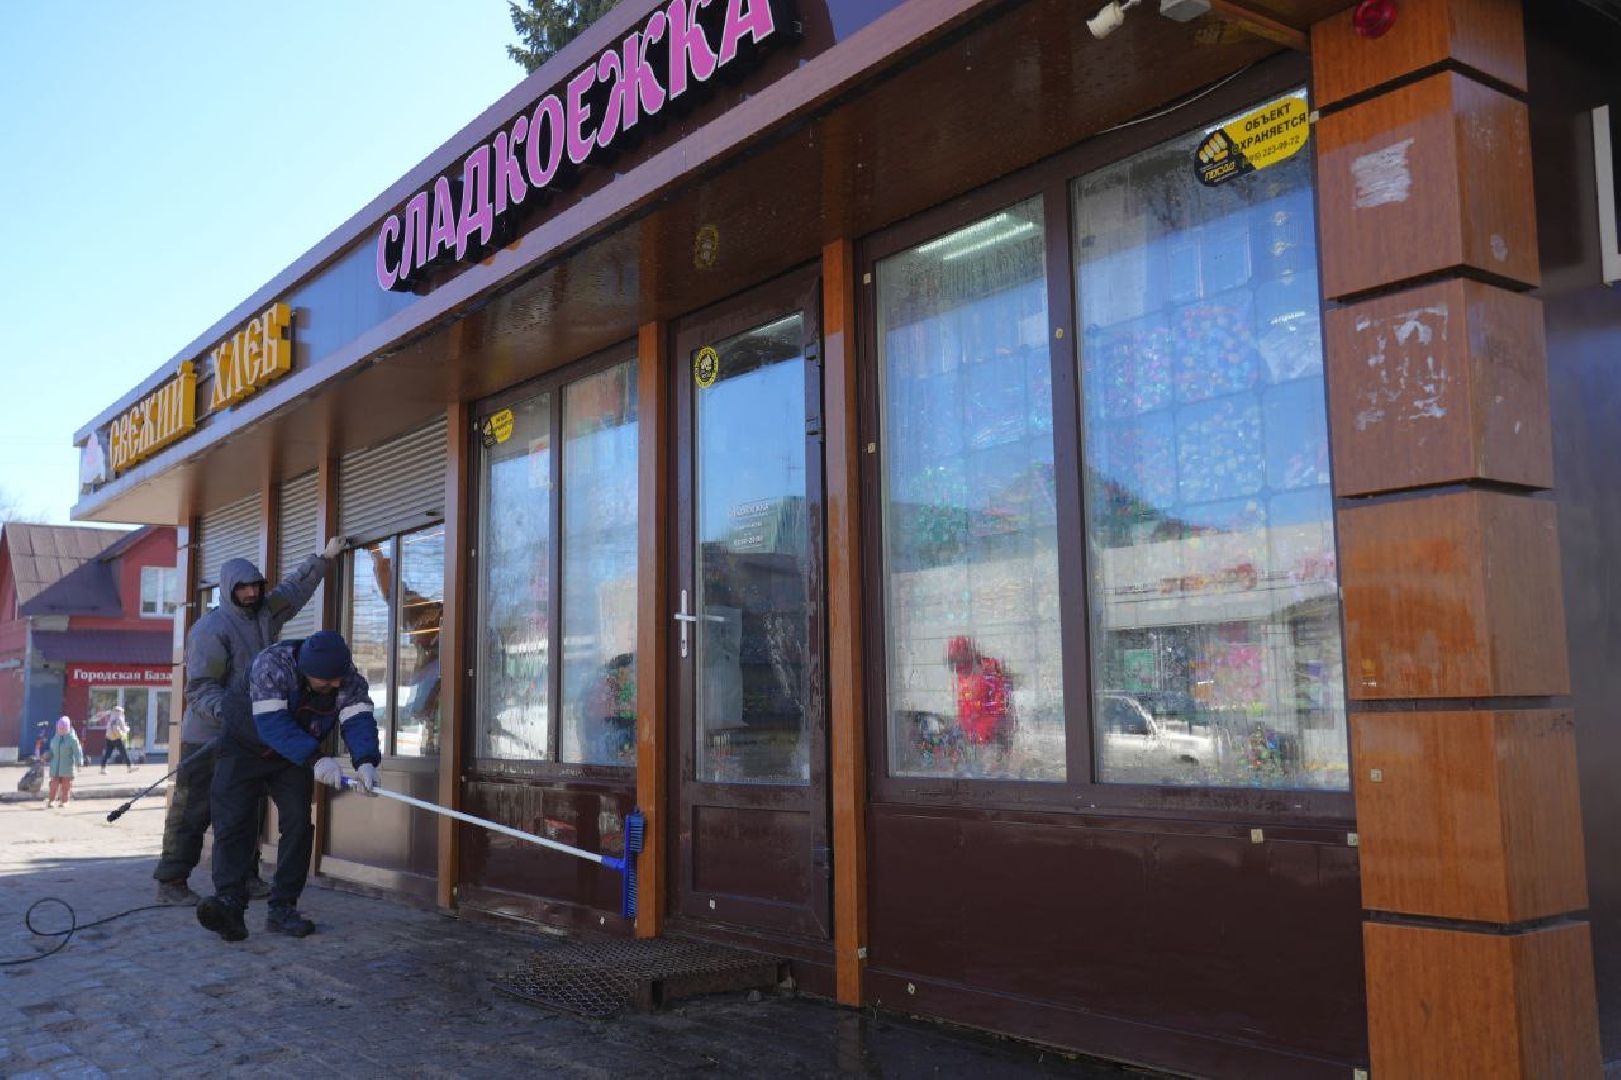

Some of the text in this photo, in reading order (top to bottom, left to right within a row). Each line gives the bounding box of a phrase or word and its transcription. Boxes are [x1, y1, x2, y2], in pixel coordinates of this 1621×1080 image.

[376, 0, 775, 291] СЛАДКОЕЖКА
[1245, 102, 1291, 132] ОБЪЕКТ
[109, 303, 288, 472] СВЕЖИЙ ХЛЕБ
[73, 669, 141, 682] Городская
